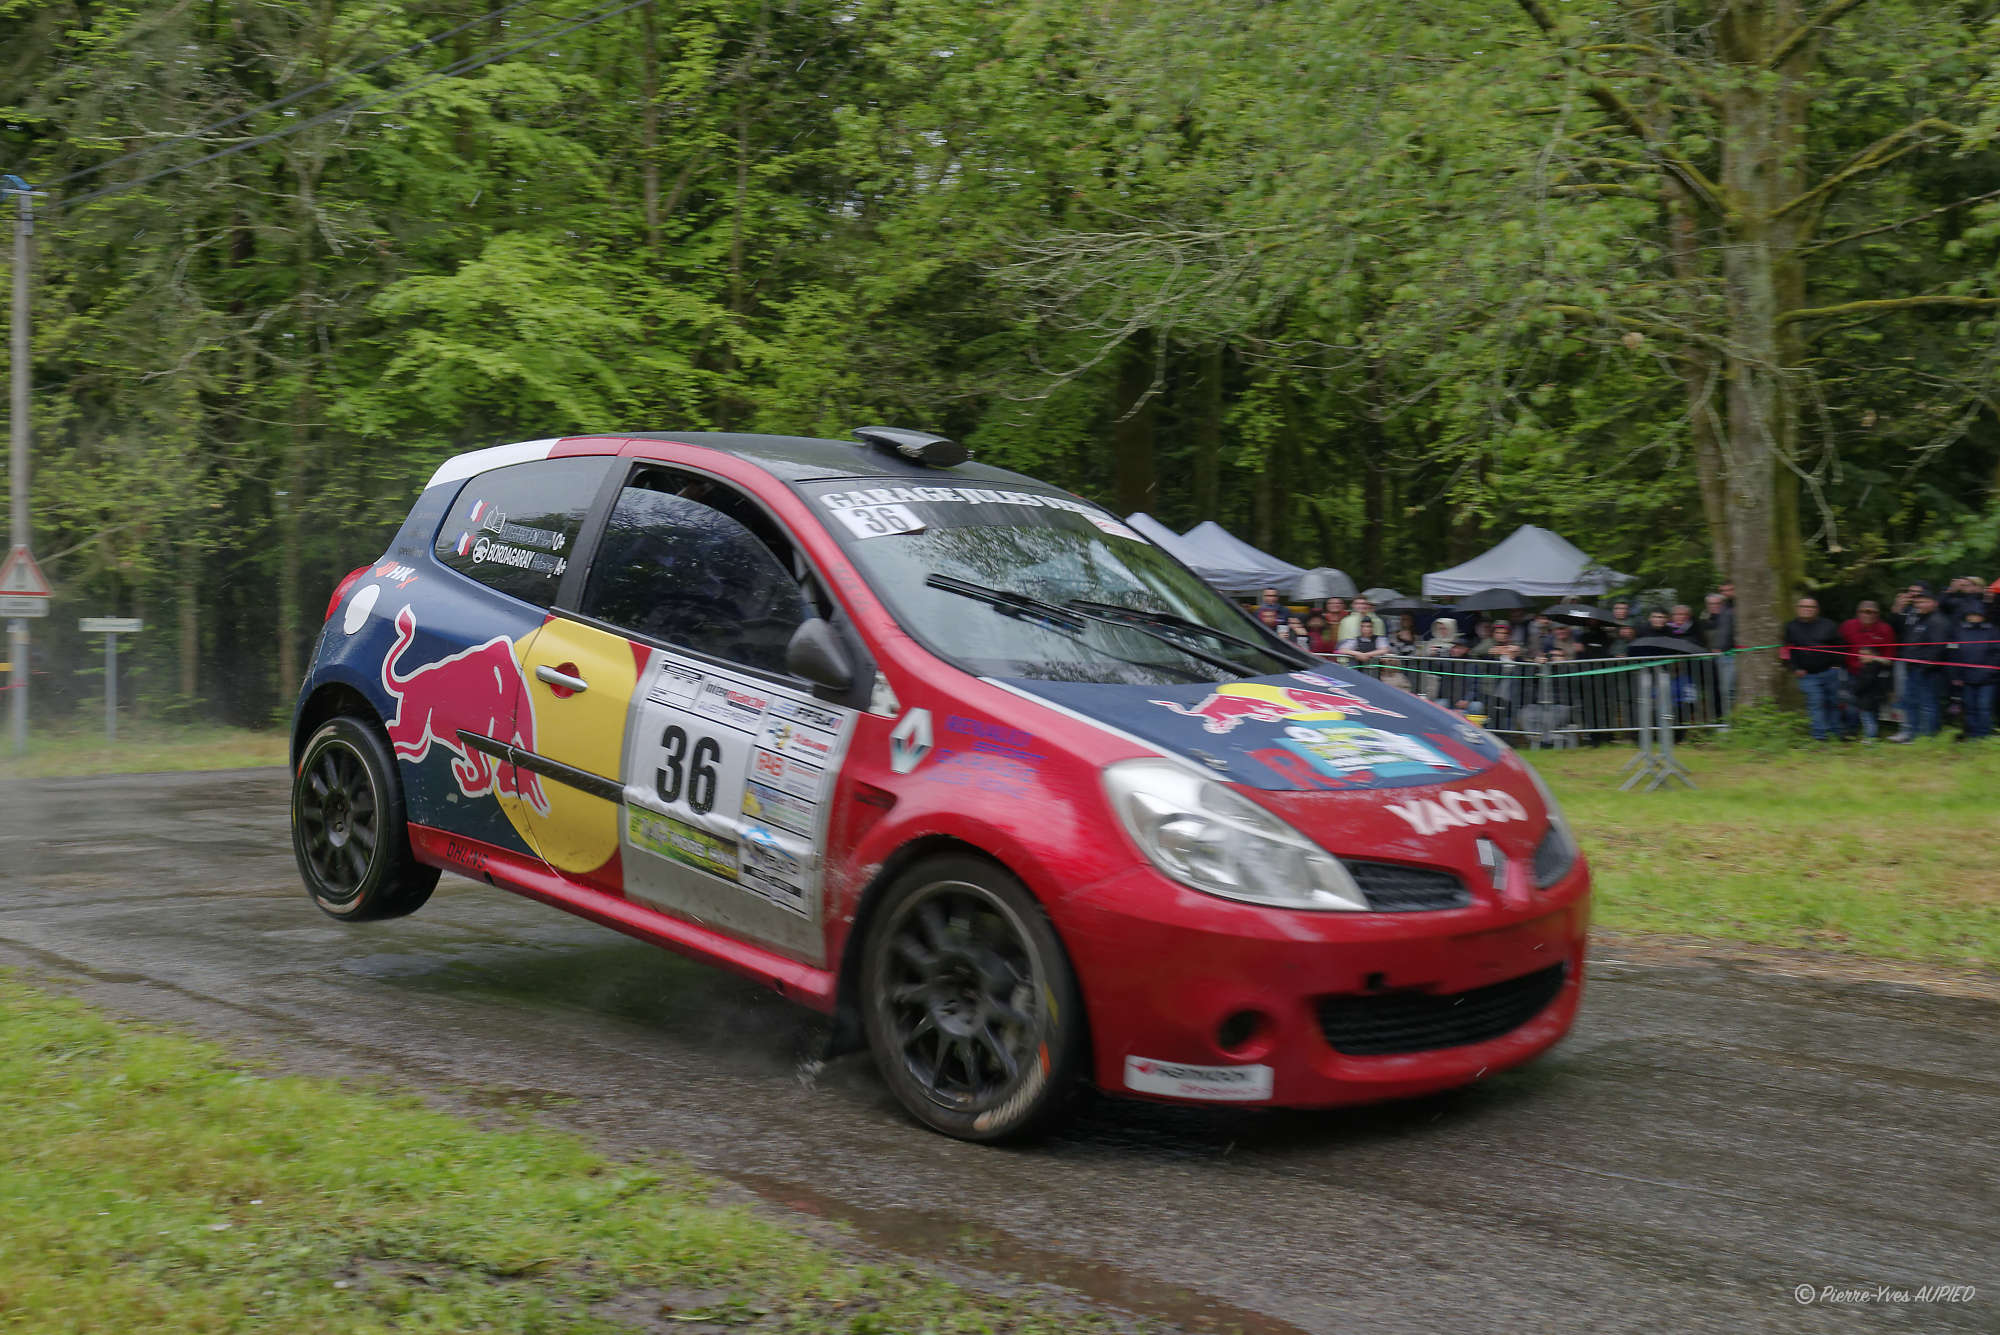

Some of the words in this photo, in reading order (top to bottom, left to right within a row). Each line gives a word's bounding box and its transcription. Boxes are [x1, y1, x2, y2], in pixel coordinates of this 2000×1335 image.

[819, 486, 960, 509] GARAGE
[854, 507, 909, 533] 36
[487, 543, 535, 569] BORDAGARAY
[656, 725, 722, 816] 36
[1384, 788, 1528, 836] YACCO
